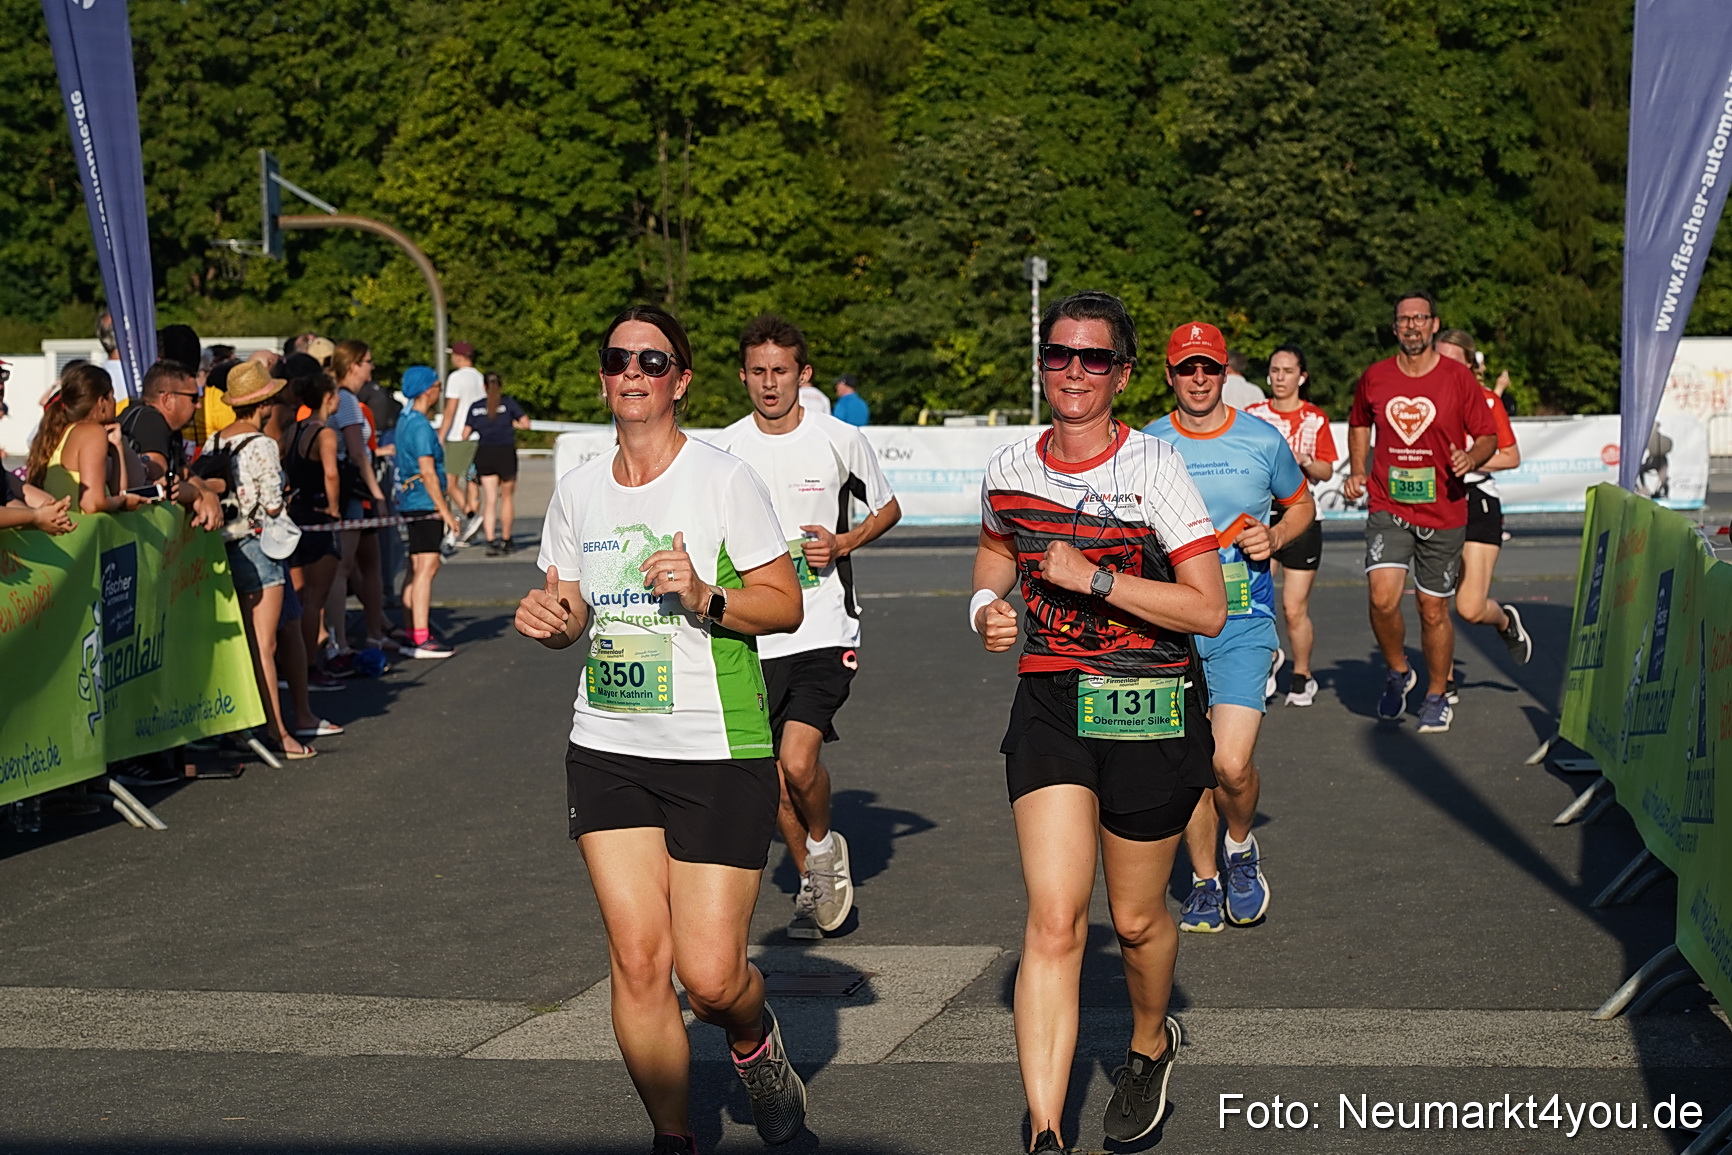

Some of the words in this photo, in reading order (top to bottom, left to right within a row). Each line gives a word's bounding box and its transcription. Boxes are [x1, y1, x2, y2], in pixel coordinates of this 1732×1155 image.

[1655, 70, 1732, 333] www.fischer-automo
[1186, 461, 1230, 470] aiffeisenbank
[1400, 480, 1424, 492] 383
[583, 540, 620, 553] BERATA
[1240, 582, 1249, 607] 2022
[588, 666, 596, 693] RUN
[599, 660, 645, 688] 350
[657, 665, 668, 702] 2022
[597, 686, 618, 698] Mayer
[619, 689, 653, 699] Kathrin
[1106, 689, 1156, 715] 131
[1084, 697, 1094, 722] RUN
[1093, 715, 1146, 726] Obermeier
[1147, 716, 1170, 725] Silke
